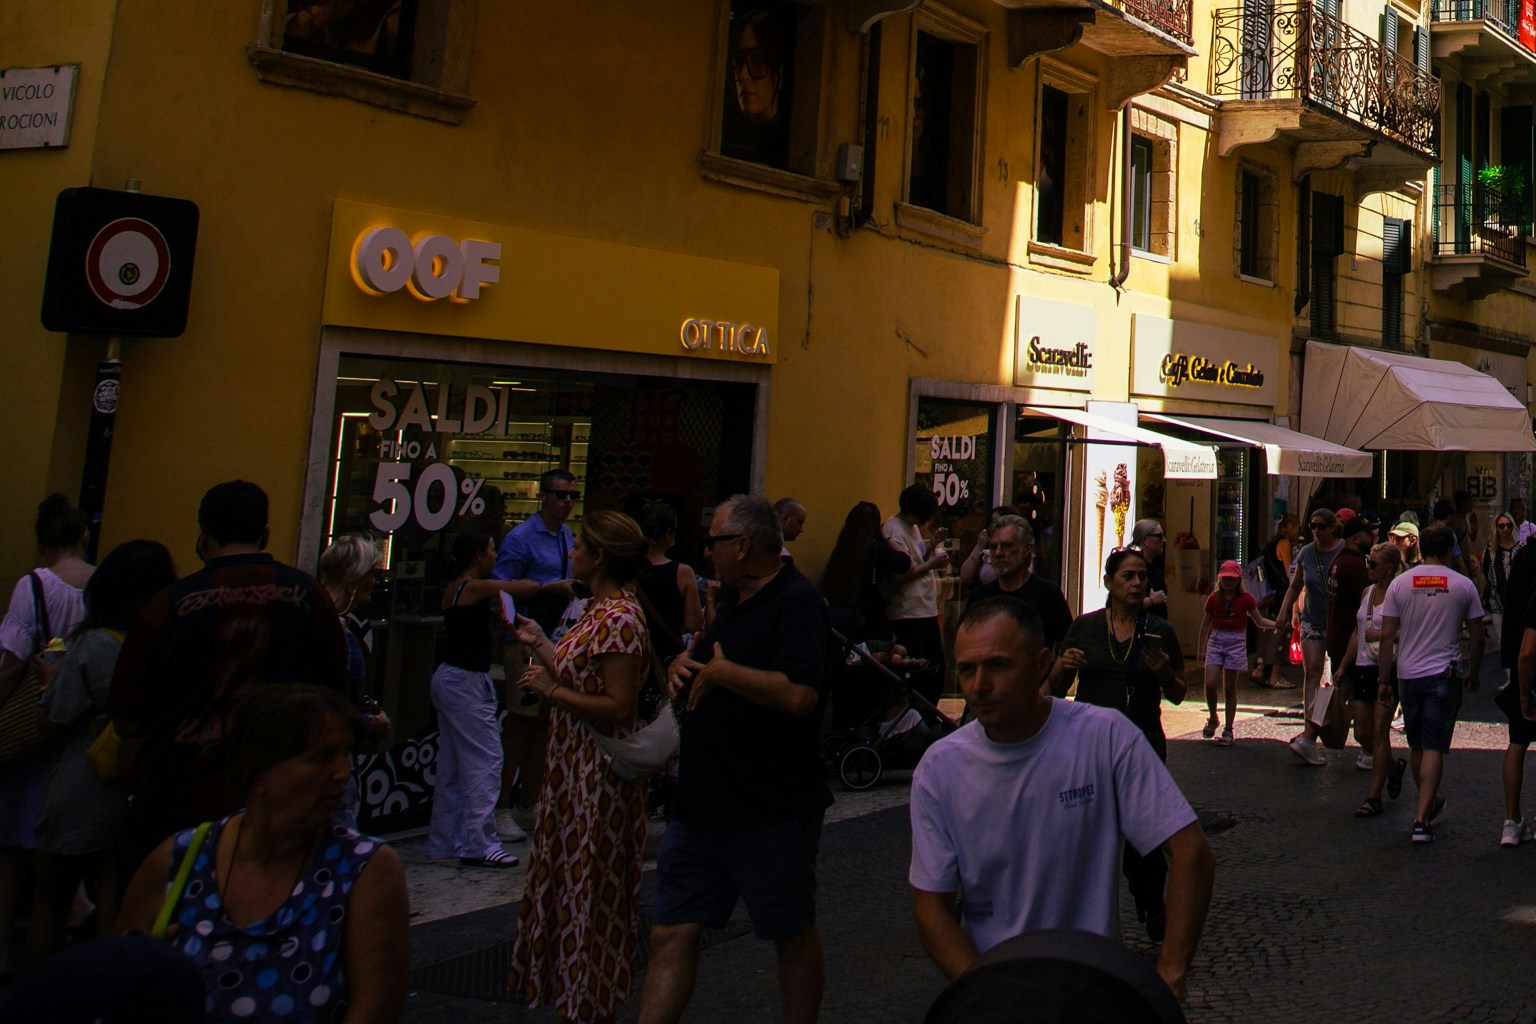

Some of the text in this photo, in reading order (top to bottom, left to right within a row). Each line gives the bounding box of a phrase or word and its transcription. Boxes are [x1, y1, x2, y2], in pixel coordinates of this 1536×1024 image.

[3, 83, 55, 101] VICOLO
[354, 225, 502, 299] OOF
[681, 317, 771, 355] OTTICA
[368, 378, 511, 436] SALDI
[380, 440, 438, 459] FINO A
[931, 435, 976, 460] SALDI
[934, 463, 948, 472] FINO
[368, 462, 487, 532] 50%
[932, 473, 970, 507] 50%
